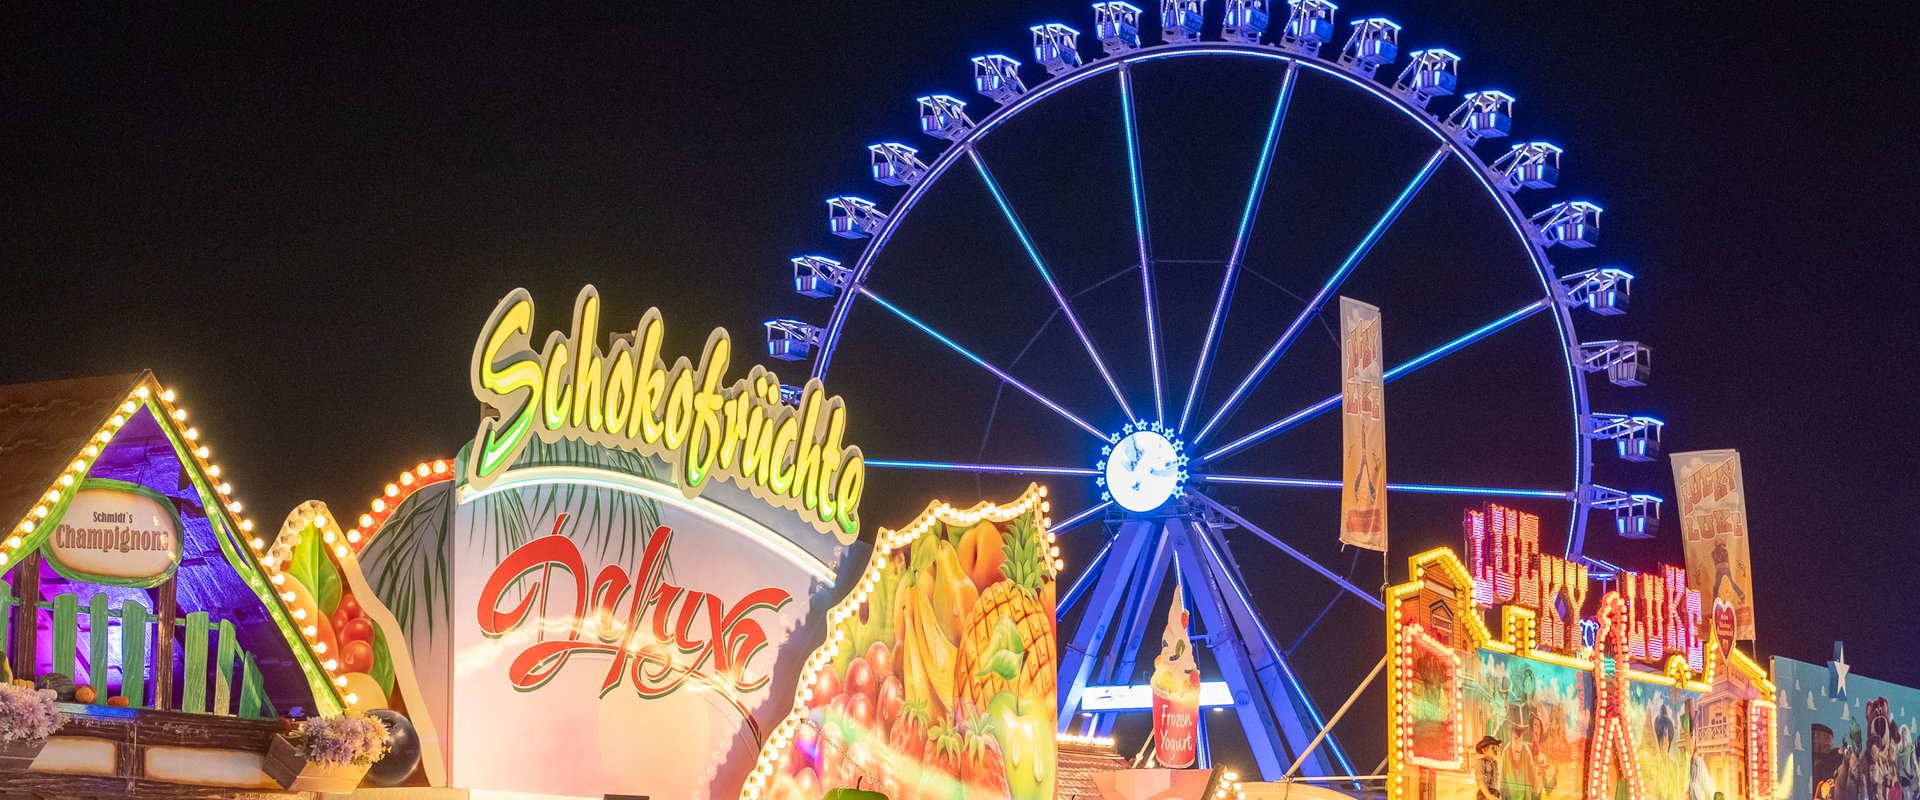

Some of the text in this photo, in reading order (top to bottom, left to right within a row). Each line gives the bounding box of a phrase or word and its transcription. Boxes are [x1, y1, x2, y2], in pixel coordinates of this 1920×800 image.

[478, 293, 866, 535] Schokofrüchte
[1679, 457, 1737, 516] LUCKY
[1686, 507, 1744, 541] LUKE
[477, 513, 793, 700] Deluxe
[1471, 503, 1704, 672] LUCKY LUKE
[1160, 729, 1193, 761] Yogurt
[1161, 704, 1193, 728] Frozen
